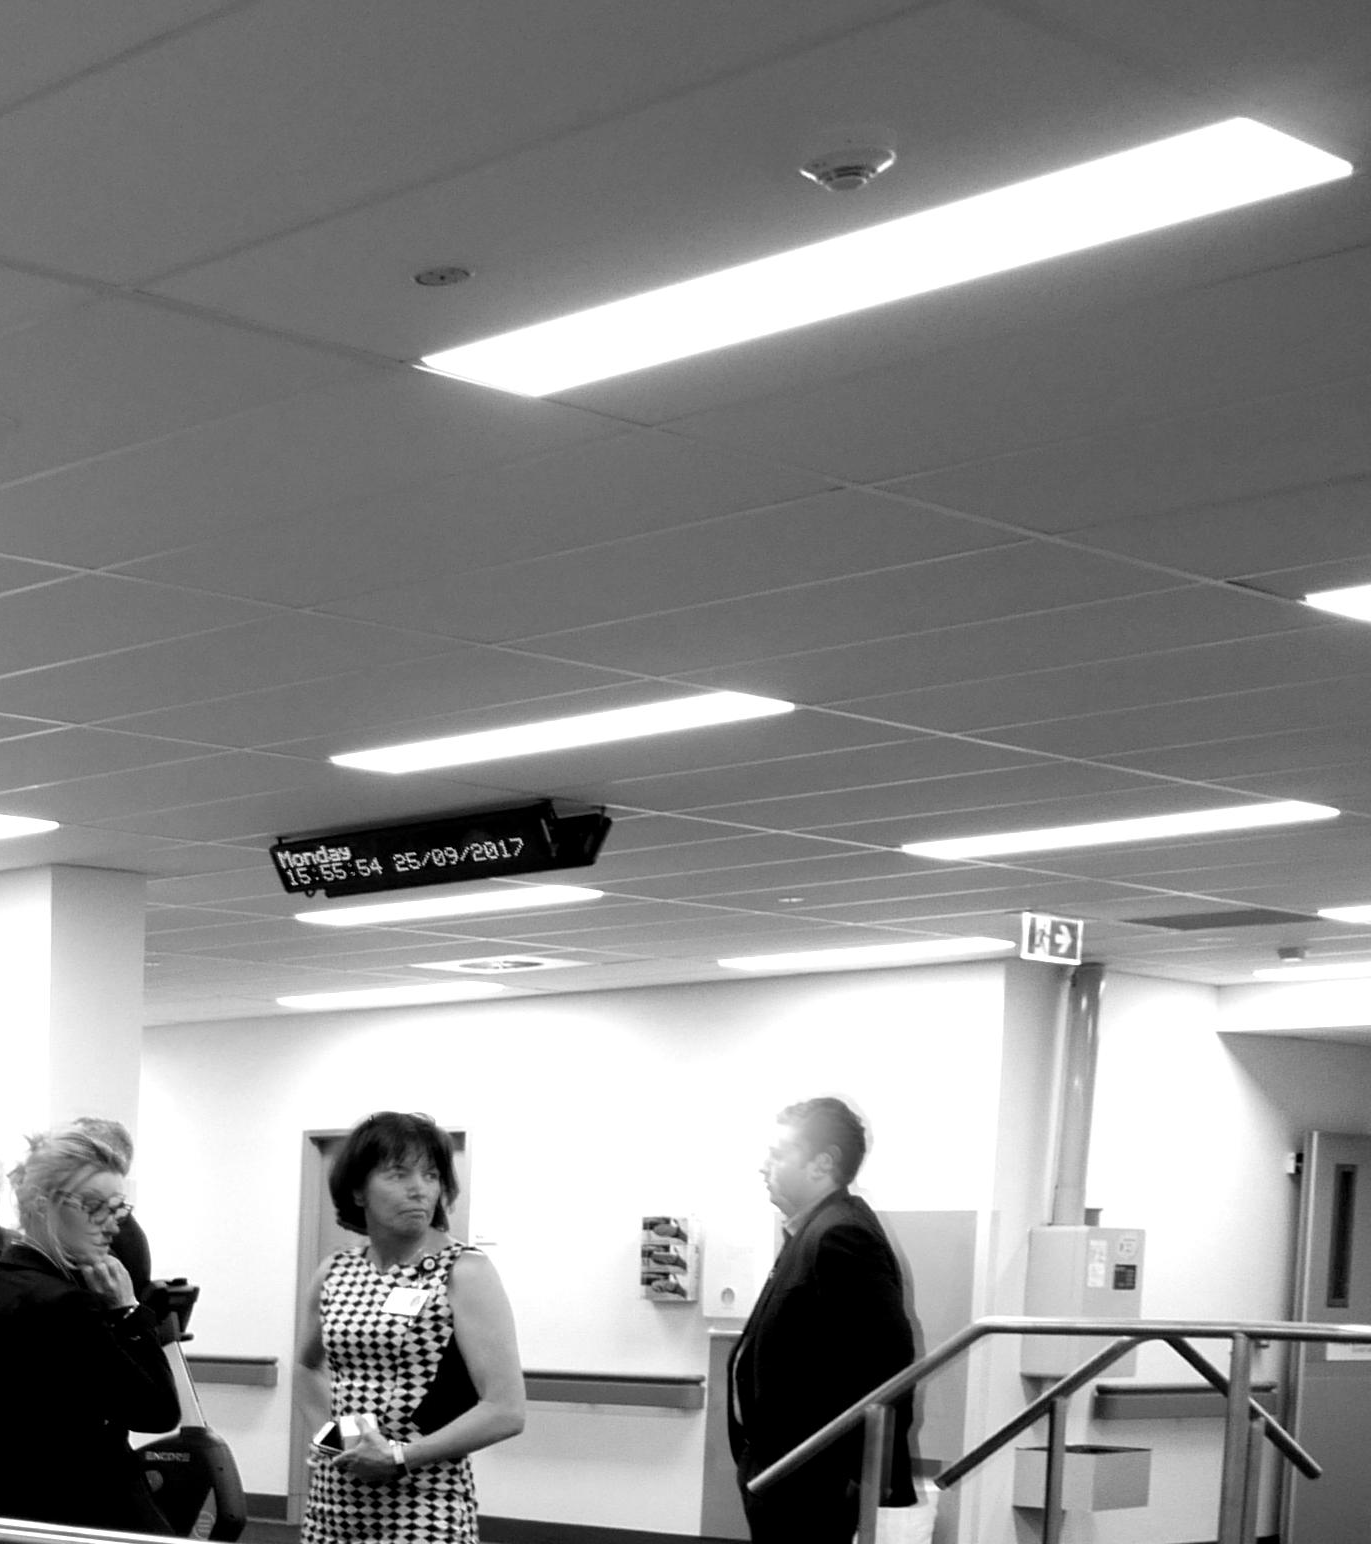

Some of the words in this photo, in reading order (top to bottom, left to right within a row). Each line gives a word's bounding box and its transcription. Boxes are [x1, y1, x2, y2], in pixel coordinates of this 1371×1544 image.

[276, 844, 352, 870] Monday
[285, 856, 384, 887] 15:55:54
[392, 836, 525, 873] 25/09/2017
